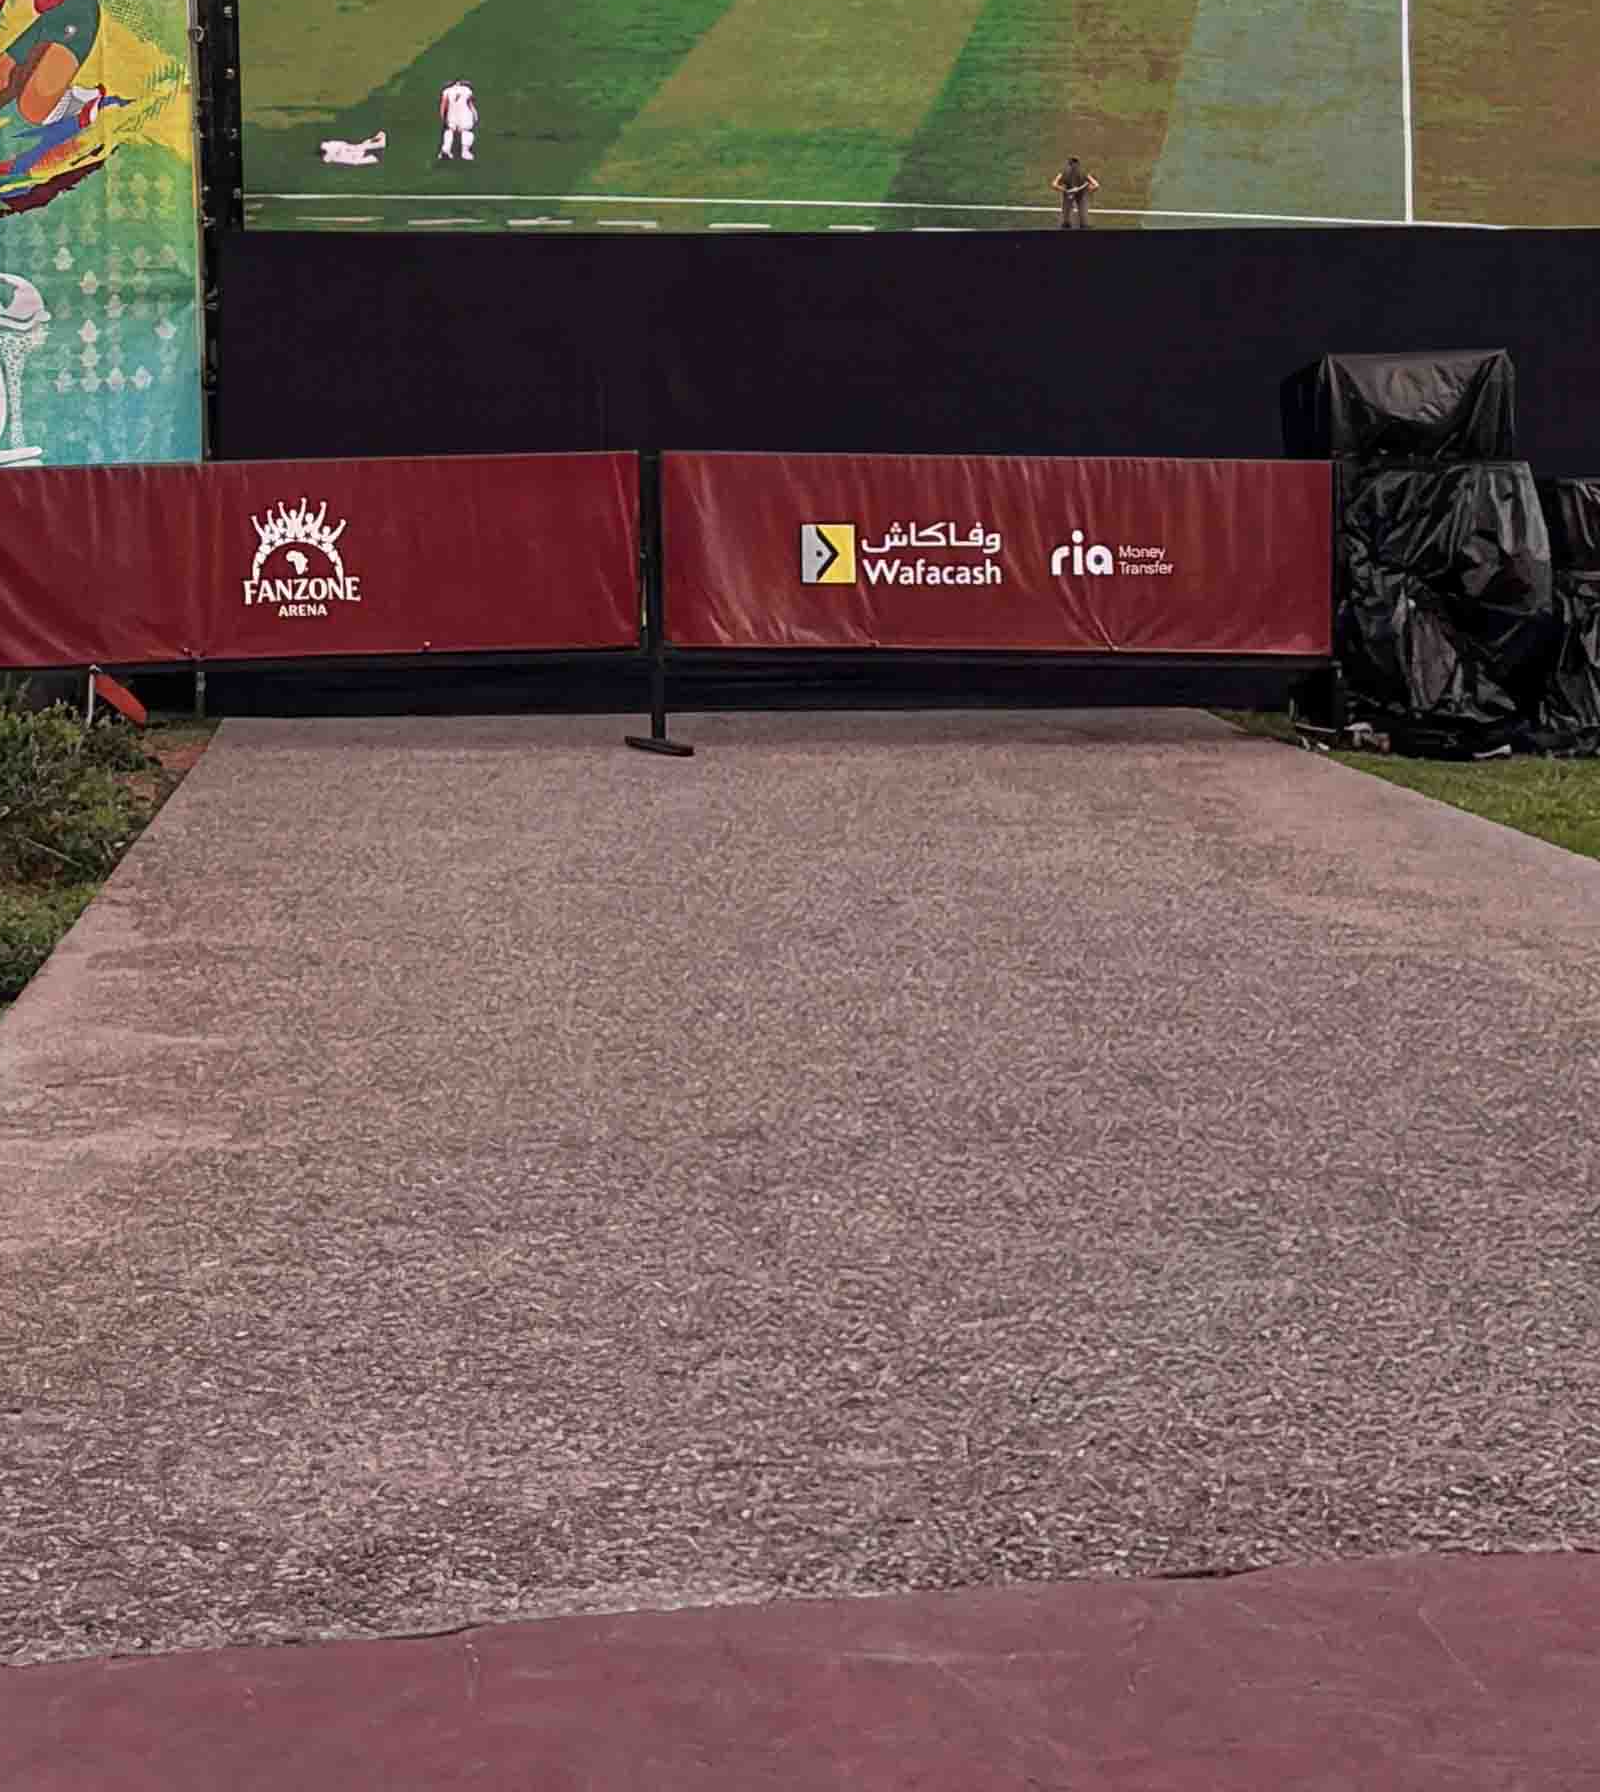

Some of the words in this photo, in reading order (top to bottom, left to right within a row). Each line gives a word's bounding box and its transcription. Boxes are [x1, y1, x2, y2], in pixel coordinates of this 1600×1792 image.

[861, 521, 1001, 554] وفاكاش
[1051, 529, 1114, 575] ria
[1119, 545, 1166, 559] Money
[862, 558, 1002, 585] Wafacash
[1118, 560, 1174, 575] Transfer
[243, 576, 361, 605] FANZONE
[278, 603, 328, 616] ARENA
